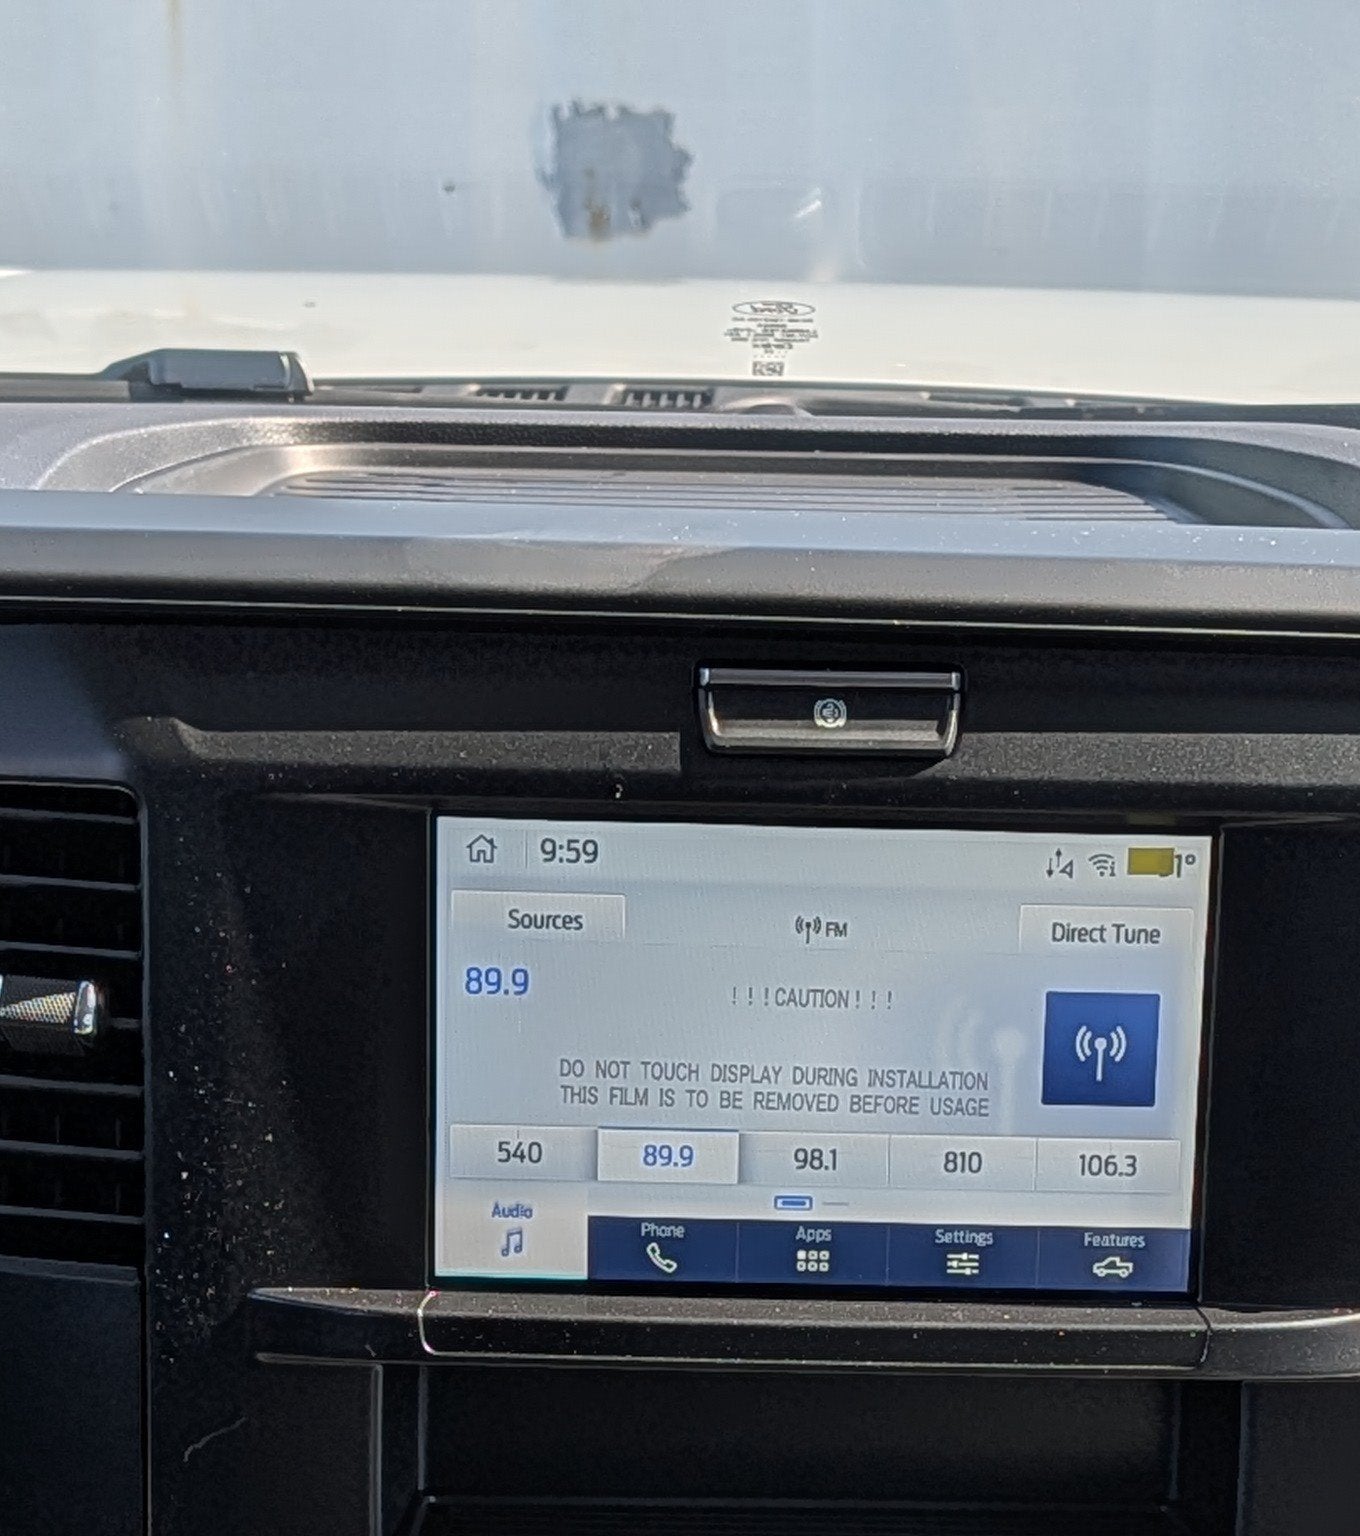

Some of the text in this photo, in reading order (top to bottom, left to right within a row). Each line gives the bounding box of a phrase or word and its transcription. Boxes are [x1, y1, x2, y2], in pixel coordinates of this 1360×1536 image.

[540, 838, 599, 863] 9:59
[507, 909, 584, 931] Sources
[825, 921, 848, 937] FM
[1052, 922, 1161, 945] Direct Tune
[464, 967, 530, 995] 89.9
[559, 1059, 989, 1091] DO NOT TOUCH DISPLAY DURING INSTALLATION
[560, 1085, 990, 1117] THIS FILM IS TO BE REMOVED BEFORE USAGE
[497, 1141, 1138, 1177] 540 89.9 98.1 810 106.3
[491, 1201, 533, 1219] Audio
[641, 1222, 1146, 1248] Phone Apps Settings Features
